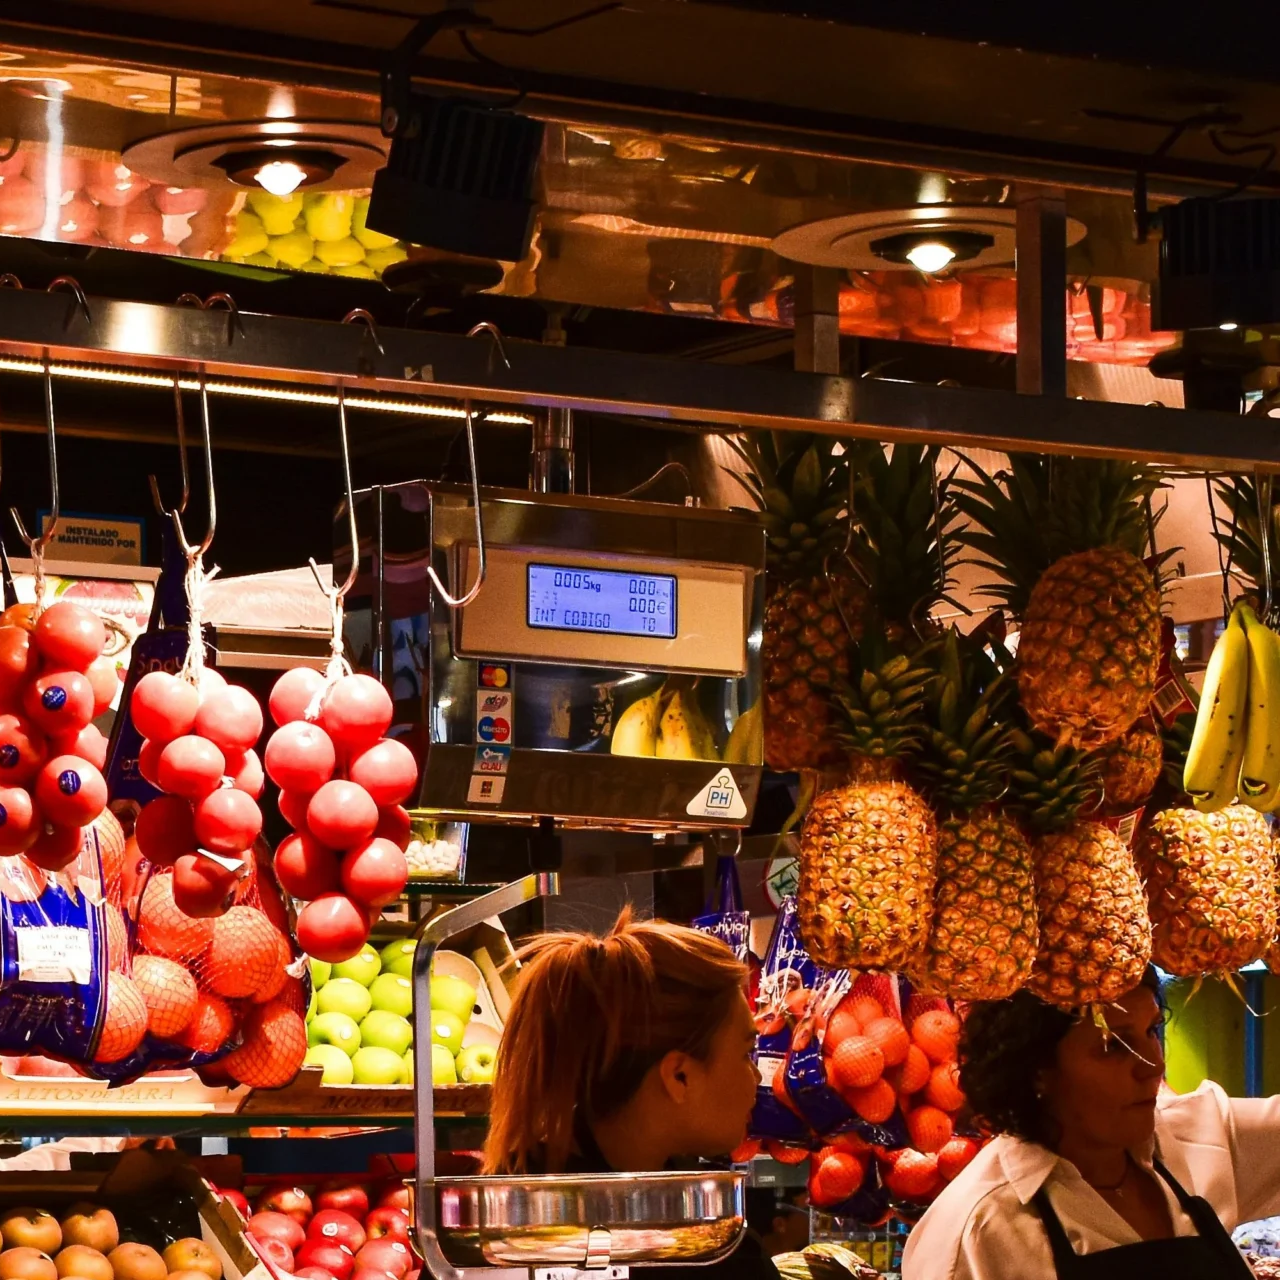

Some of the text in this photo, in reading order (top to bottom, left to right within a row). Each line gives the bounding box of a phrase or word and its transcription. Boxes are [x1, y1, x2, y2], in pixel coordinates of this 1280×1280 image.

[66, 526, 119, 538] INSTALADO
[58, 535, 115, 547] MANTENIDO
[117, 540, 136, 548] POR
[533, 607, 556, 622] INT
[482, 725, 508, 735] Maestro
[710, 791, 729, 805] PH
[5, 1088, 87, 1101] ALTOS
[119, 1088, 174, 1100] YARA
